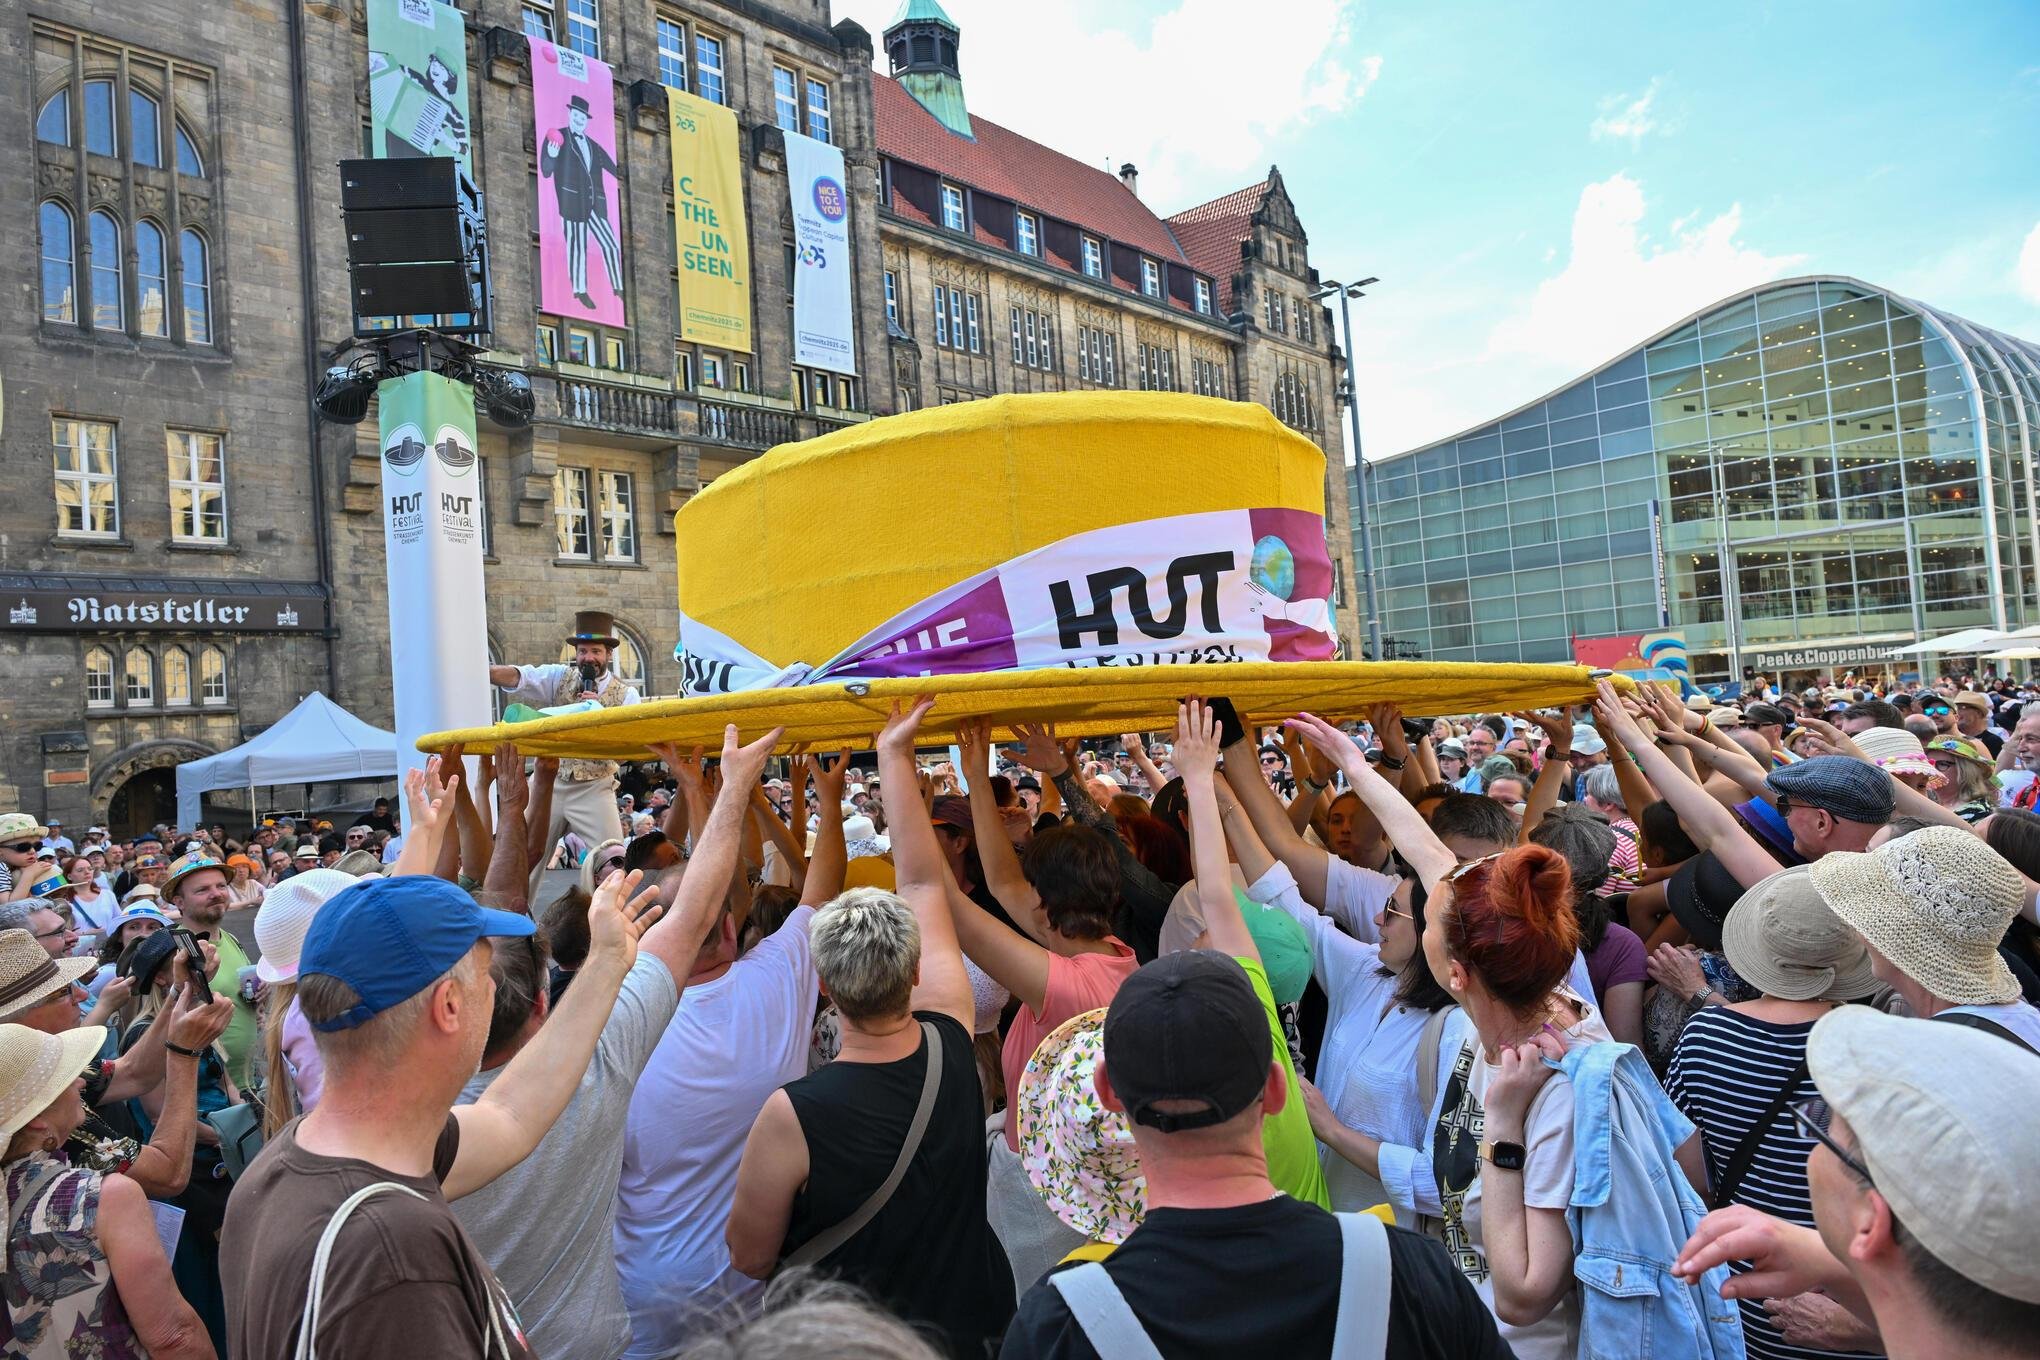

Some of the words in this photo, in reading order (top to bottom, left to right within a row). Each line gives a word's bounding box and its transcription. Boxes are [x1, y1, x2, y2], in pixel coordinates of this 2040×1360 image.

[817, 185, 838, 196] NICE
[820, 196, 832, 205] TO
[832, 197, 840, 206] C
[680, 200, 720, 228] THE
[391, 491, 423, 515] HUT
[441, 492, 473, 515] HUT
[67, 597, 250, 624] Ratskeller
[1048, 550, 1236, 650] HUT
[1756, 645, 1905, 668] Peek&Cloppenburg
